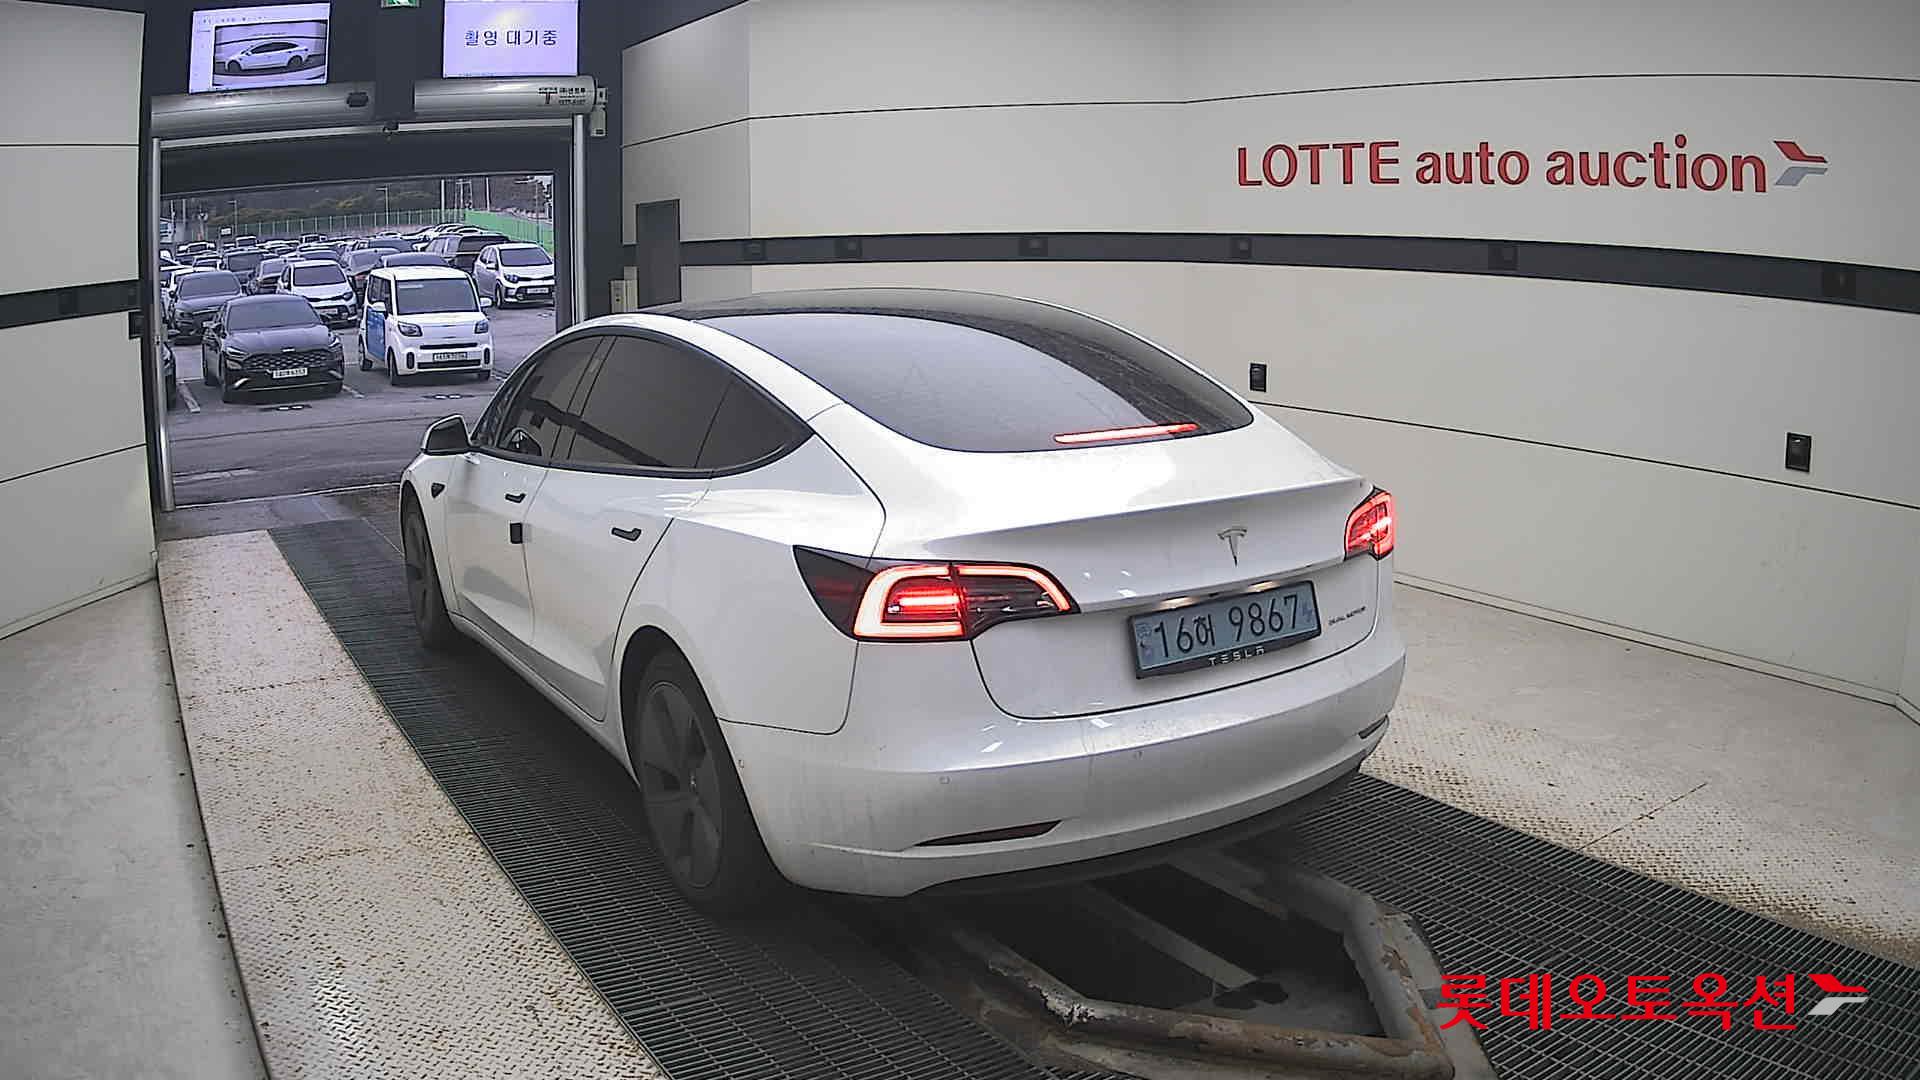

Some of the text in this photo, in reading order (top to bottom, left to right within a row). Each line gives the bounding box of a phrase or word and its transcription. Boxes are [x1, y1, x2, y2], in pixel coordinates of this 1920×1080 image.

[506, 29, 558, 46] 대기중
[1237, 134, 1768, 194] LOTTE auto auction
[1154, 613, 1216, 658] 16허
[1228, 594, 1298, 642] 9867
[1208, 645, 1265, 667] TESLA
